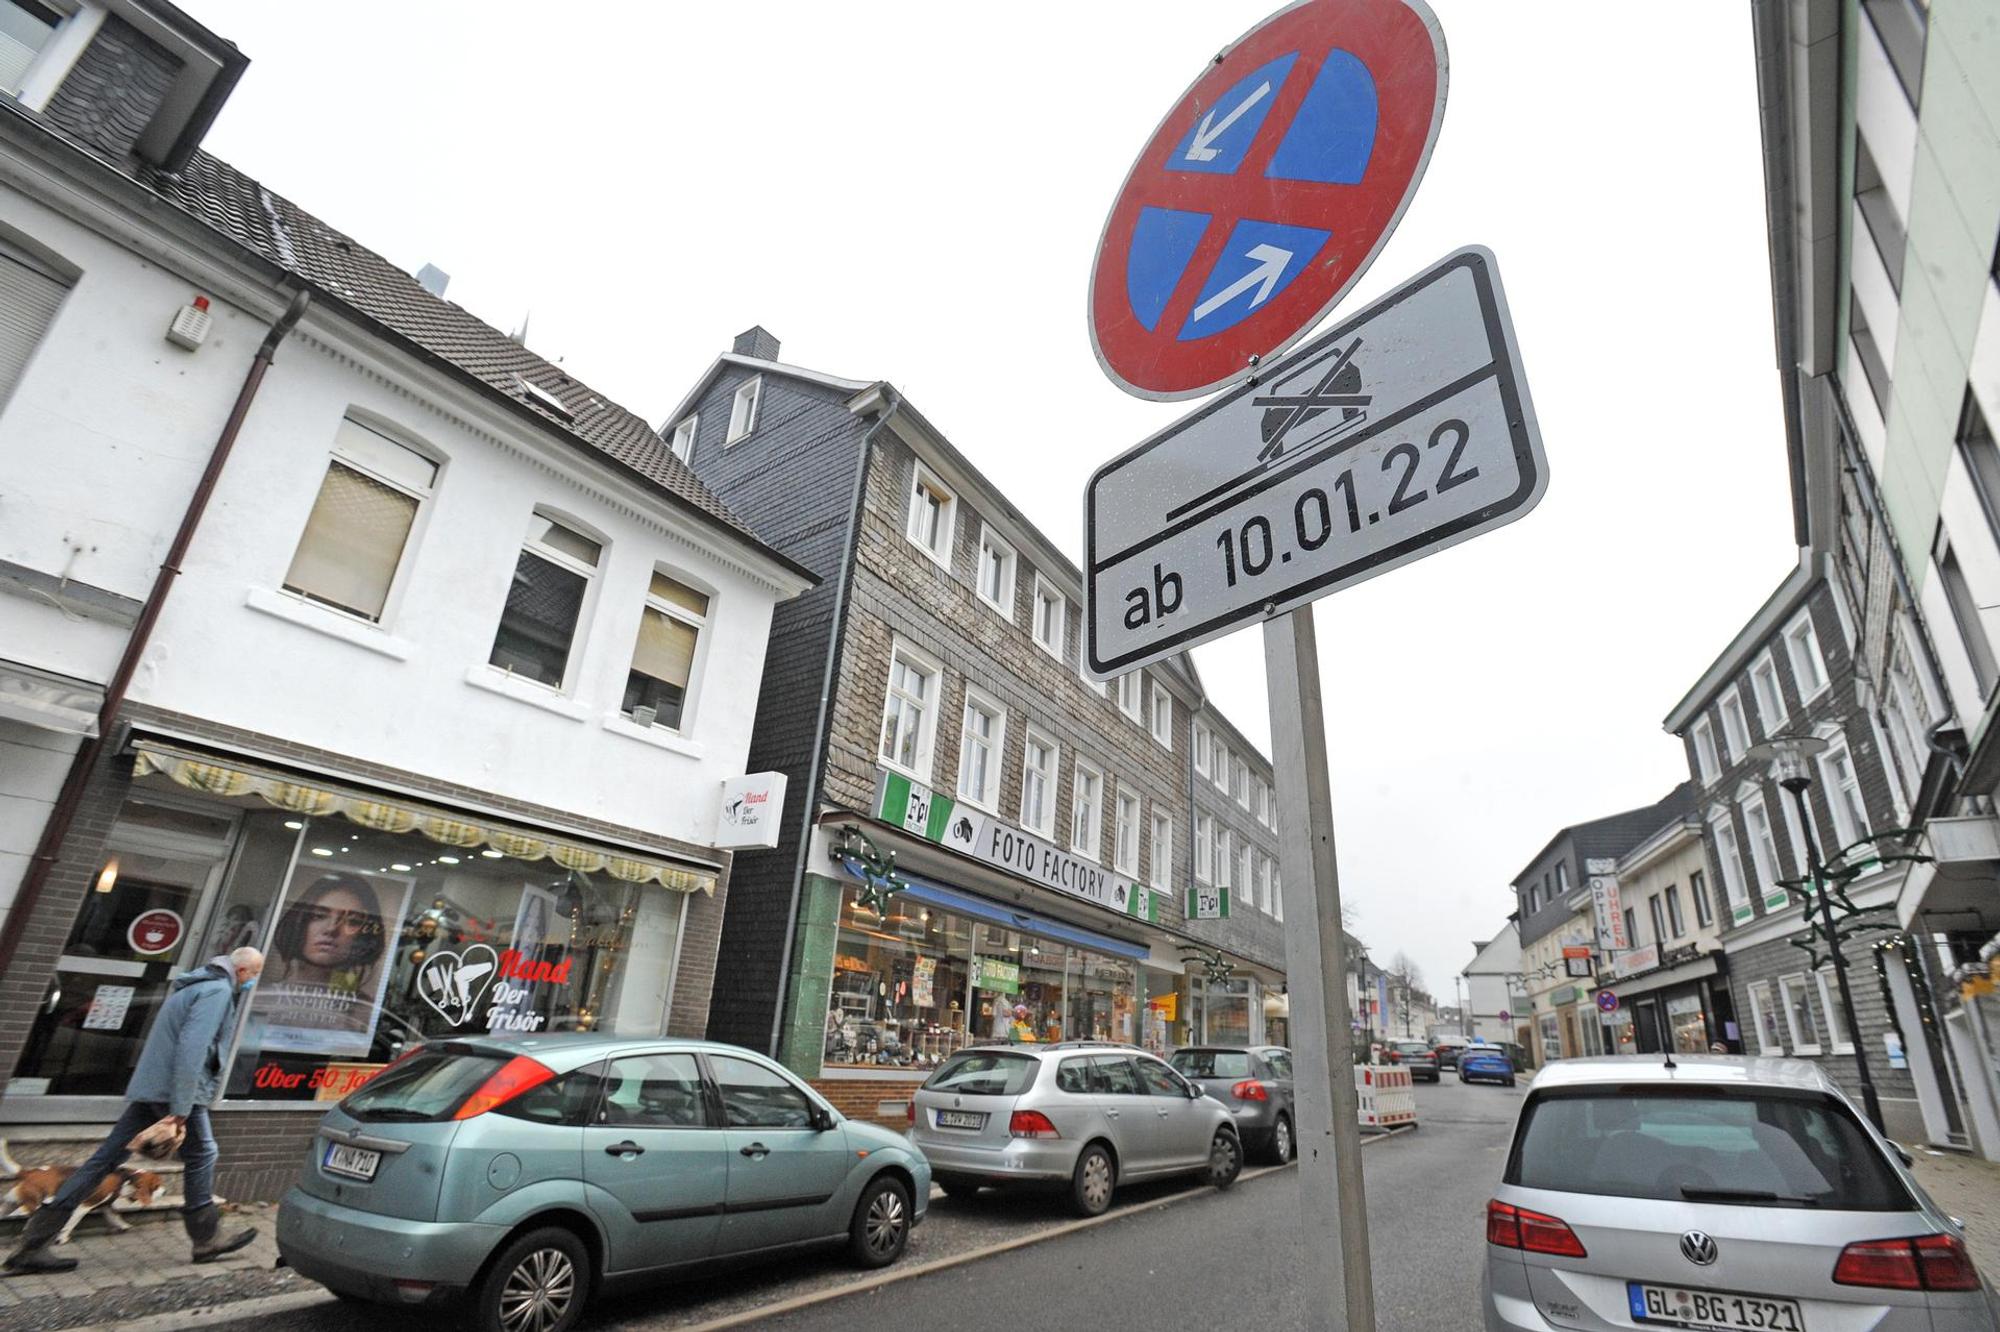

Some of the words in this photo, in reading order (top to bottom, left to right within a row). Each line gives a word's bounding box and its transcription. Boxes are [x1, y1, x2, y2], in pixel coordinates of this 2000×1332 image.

[1124, 563, 1183, 630] ab
[1216, 419, 1480, 588] 10.01.22
[992, 827, 1035, 872] FOTO
[1043, 850, 1105, 899] FACTORY
[1592, 879, 1611, 938] OPTIK
[1607, 887, 1626, 947] UHREN
[277, 995, 350, 1012] INSPIRED
[492, 981, 528, 1004] Der
[486, 1006, 545, 1032] Frisör
[254, 1062, 307, 1089] Über
[308, 1065, 340, 1089] 50
[1646, 1289, 1678, 1317] GL
[1692, 1294, 1726, 1323] BG
[1732, 1298, 1799, 1332] 1321
